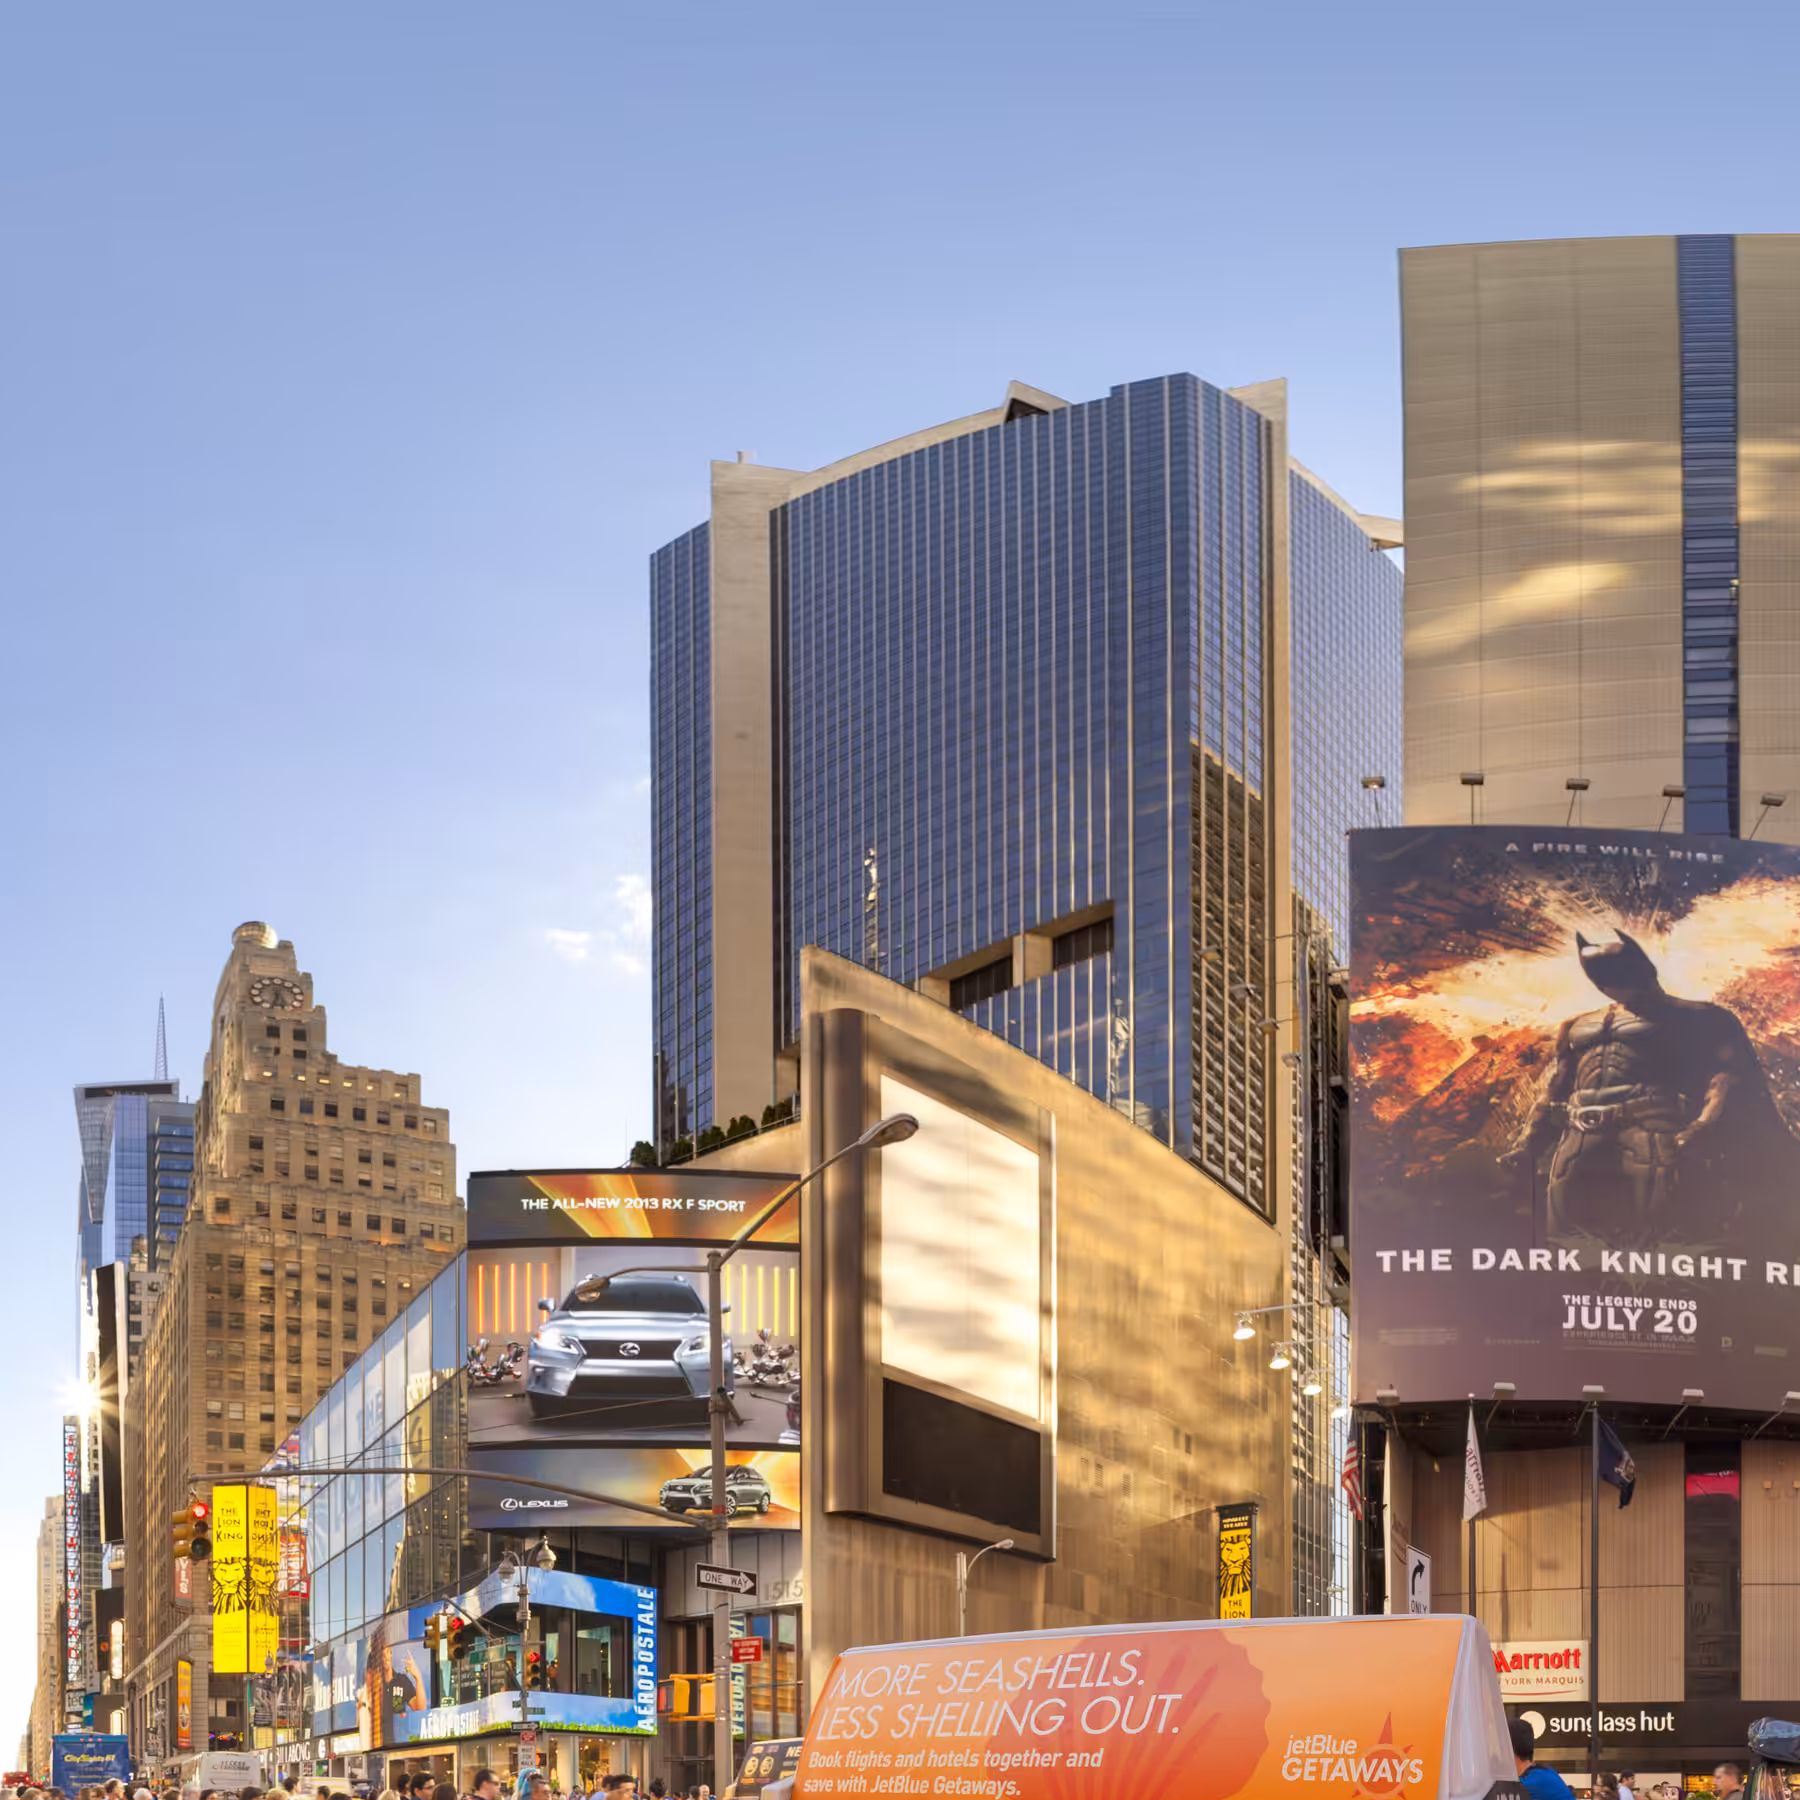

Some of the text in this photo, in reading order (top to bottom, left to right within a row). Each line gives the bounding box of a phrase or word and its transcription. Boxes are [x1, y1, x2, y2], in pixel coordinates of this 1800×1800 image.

[1505, 842, 1726, 864] A FIRE WILL RISE
[521, 1198, 745, 1213] THE ALL-NEW 2013 RX F SPORT
[1376, 1249, 1453, 1273] THE
[1471, 1247, 1583, 1272] DARK
[1601, 1250, 1748, 1282] KNIGHT
[1562, 1306, 1698, 1334] JULY 20
[220, 1507, 238, 1516] THE
[519, 1499, 569, 1509] LEXUS
[216, 1529, 243, 1542] KING
[217, 1516, 241, 1529] LION
[705, 1573, 749, 1587] ONE WAY
[631, 1587, 655, 1733] AÉROPOSTALE
[831, 1648, 1147, 1701] MORE SEASHELLS.
[816, 1693, 1181, 1744] LESS SHELLING OUT.
[1549, 1710, 1676, 1738] sunglass hut
[1285, 1734, 1358, 1760] jetBlue
[1281, 1756, 1424, 1785] GETAWAYS
